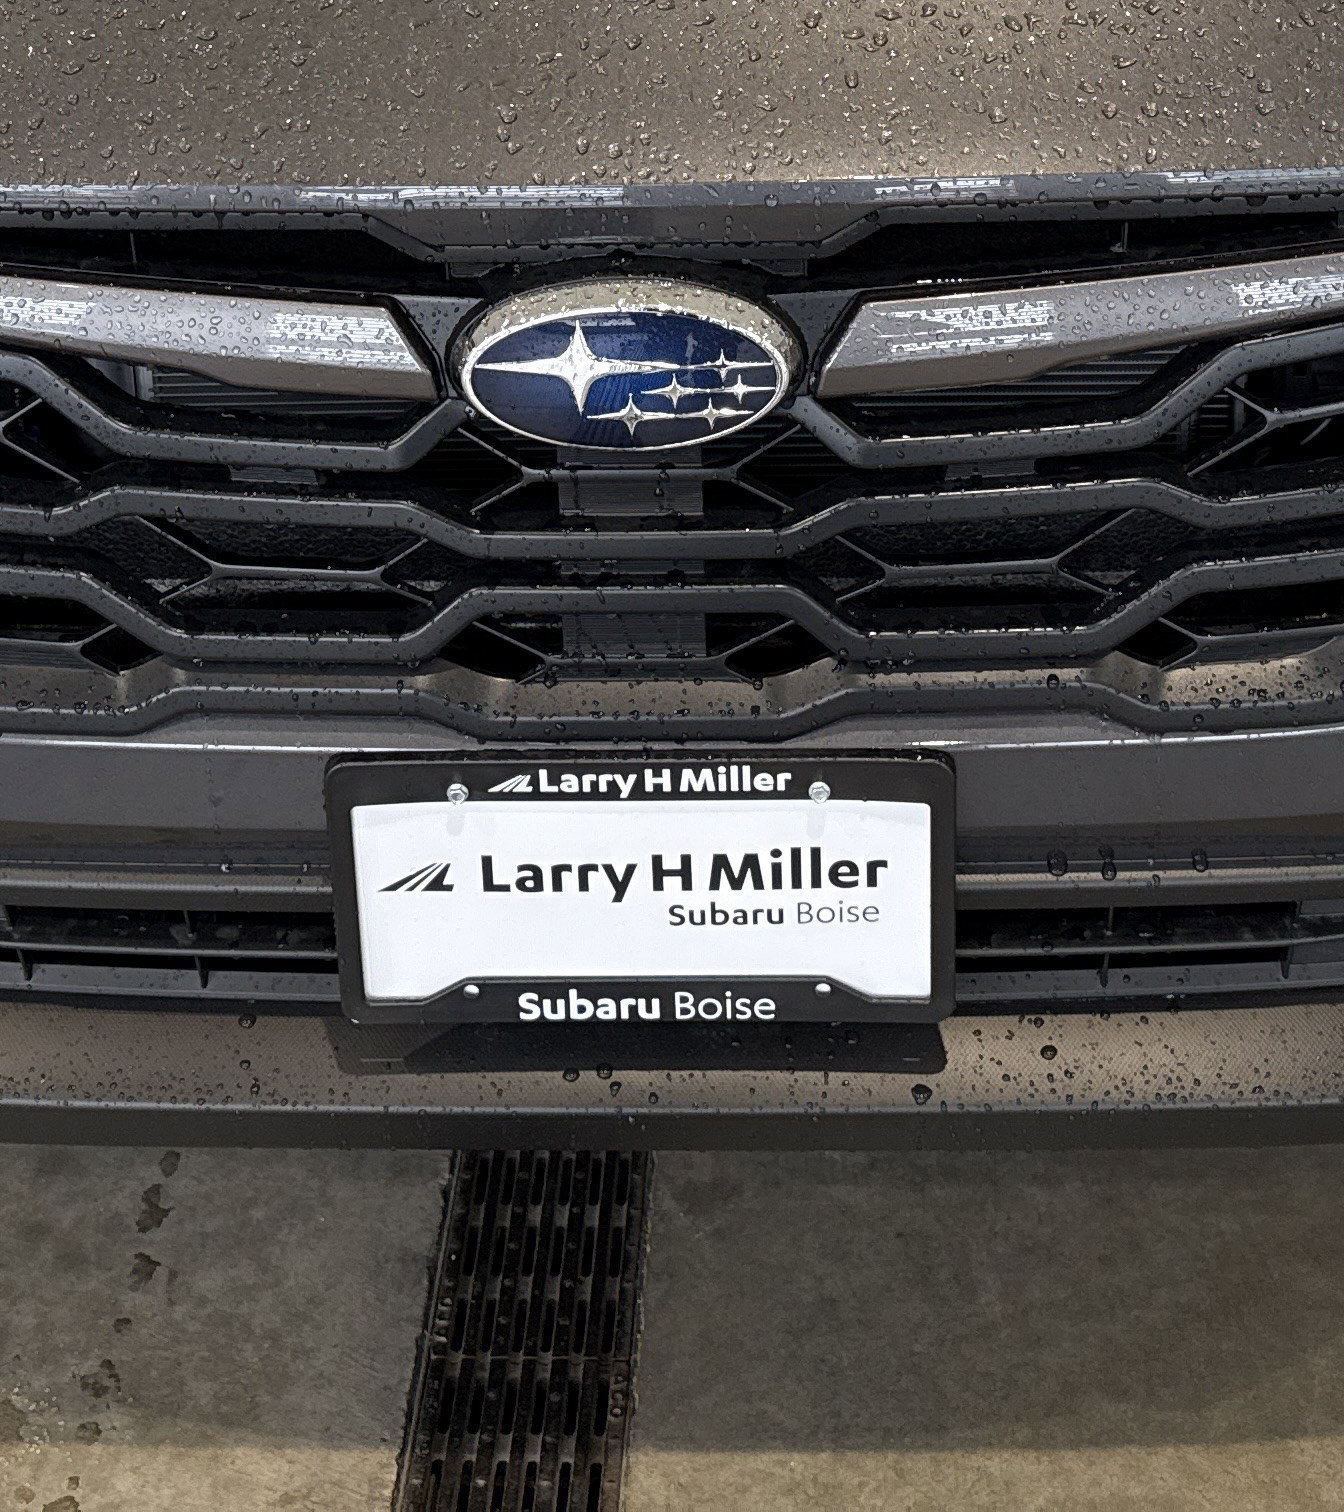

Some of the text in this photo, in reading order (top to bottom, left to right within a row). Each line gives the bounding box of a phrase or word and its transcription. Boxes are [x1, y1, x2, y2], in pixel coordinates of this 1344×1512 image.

[538, 764, 792, 799] Larry H Miller
[480, 846, 889, 903] Larry H Miller
[668, 900, 880, 927] Subaru Boise
[518, 988, 777, 1021] Subaru Boise
